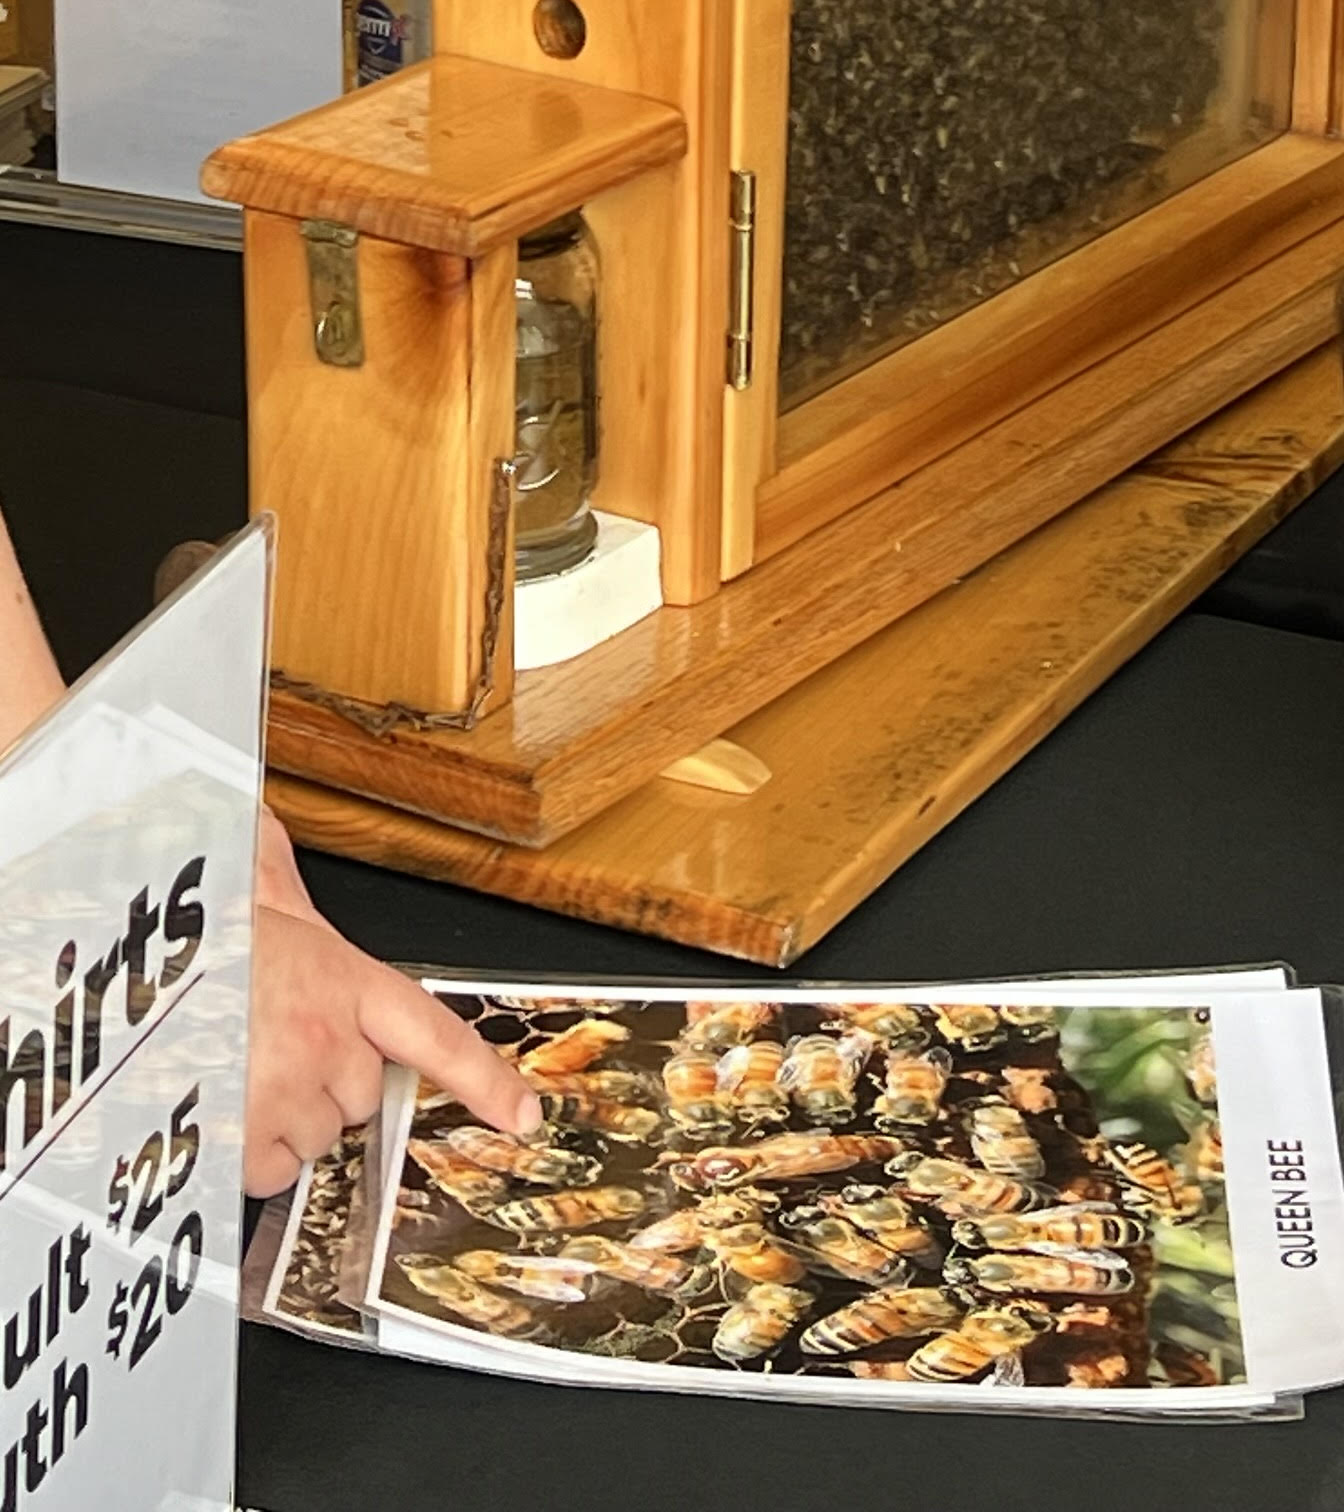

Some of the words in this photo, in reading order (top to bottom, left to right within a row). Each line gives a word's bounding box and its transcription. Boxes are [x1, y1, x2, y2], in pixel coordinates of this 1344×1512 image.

[107, 1082, 200, 1250] $25
[1267, 1139, 1306, 1181] BEE
[1272, 1189, 1318, 1269] QUEEN
[106, 1209, 205, 1373] $20
